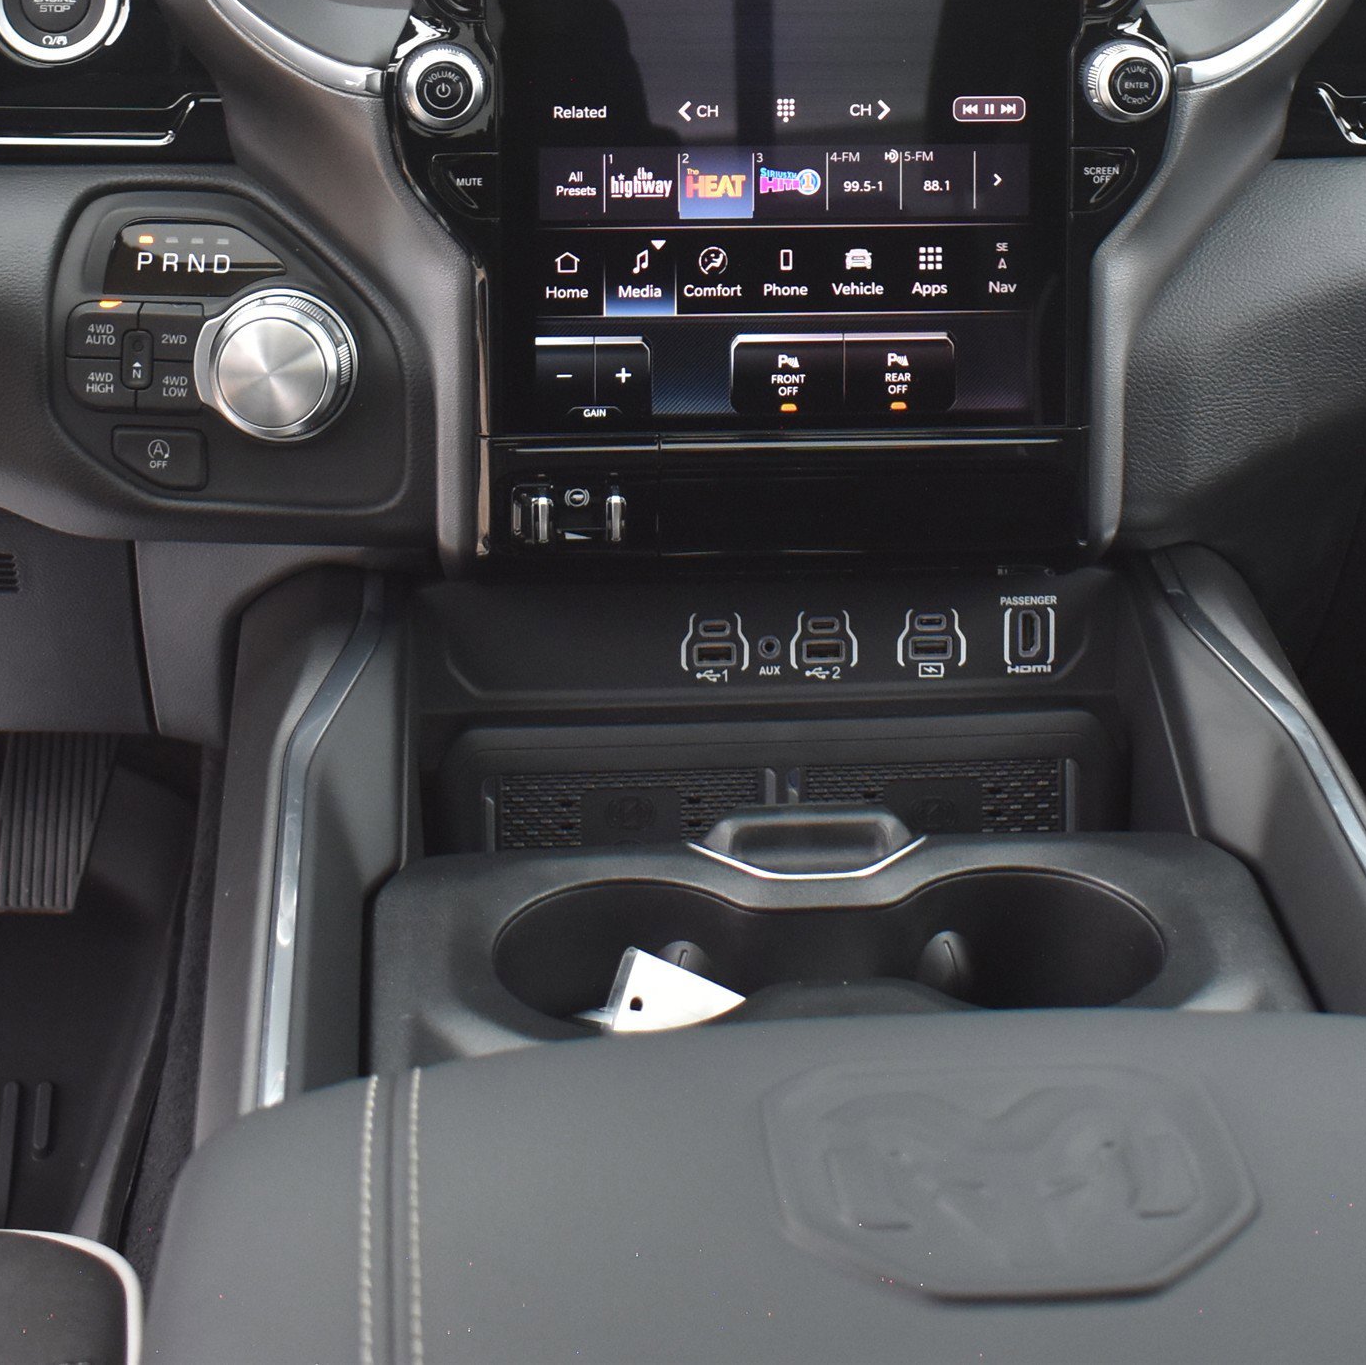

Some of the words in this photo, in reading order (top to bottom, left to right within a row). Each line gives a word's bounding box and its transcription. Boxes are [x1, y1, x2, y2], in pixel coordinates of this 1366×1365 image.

[39, 5, 71, 13] STOP
[1125, 65, 1148, 75] TUNE
[426, 70, 461, 84] VOLUME
[1124, 81, 1149, 89] ENTER
[1121, 94, 1152, 105] SCROLL
[553, 105, 607, 118] Related
[696, 105, 719, 118] CH
[849, 104, 872, 117] CH
[682, 153, 689, 164] 2
[756, 153, 764, 163] 3
[830, 152, 860, 162] 4-FM
[904, 151, 934, 162] 5-FM
[637, 166, 654, 181] the
[1083, 166, 1120, 175] SCREEN
[456, 177, 483, 186] MUTE
[568, 171, 583, 182] All
[1093, 175, 1111, 184] OFF
[556, 185, 596, 197] Presets
[610, 173, 673, 198] highway
[685, 174, 746, 198] HEAT
[843, 181, 883, 192] 99.5-1
[923, 180, 950, 191] 88.1
[996, 242, 1009, 251] SE
[546, 286, 589, 299] Home
[618, 285, 662, 298] Media
[684, 284, 742, 298] Comfort
[763, 283, 808, 297] Phone
[832, 281, 884, 296] Vehicle
[911, 282, 948, 297] Apps
[988, 281, 1017, 294] Nav
[87, 324, 114, 334] 4WD
[85, 335, 116, 345] AUTO
[161, 334, 187, 344] 2WD
[87, 372, 114, 383] 4WD
[132, 369, 142, 379] N
[771, 374, 806, 384] FRONT
[885, 372, 911, 382] REAR
[162, 376, 188, 386] 4WD
[86, 383, 114, 393] HIGH
[162, 387, 188, 397] LOW
[778, 386, 799, 396] OFF
[888, 384, 908, 394] OFF
[583, 409, 607, 418] GAIN
[149, 460, 168, 469] OFF
[999, 595, 1058, 606] PASSENGER
[721, 669, 729, 682] 1
[759, 665, 781, 676] AUX
[831, 666, 841, 679] 2
